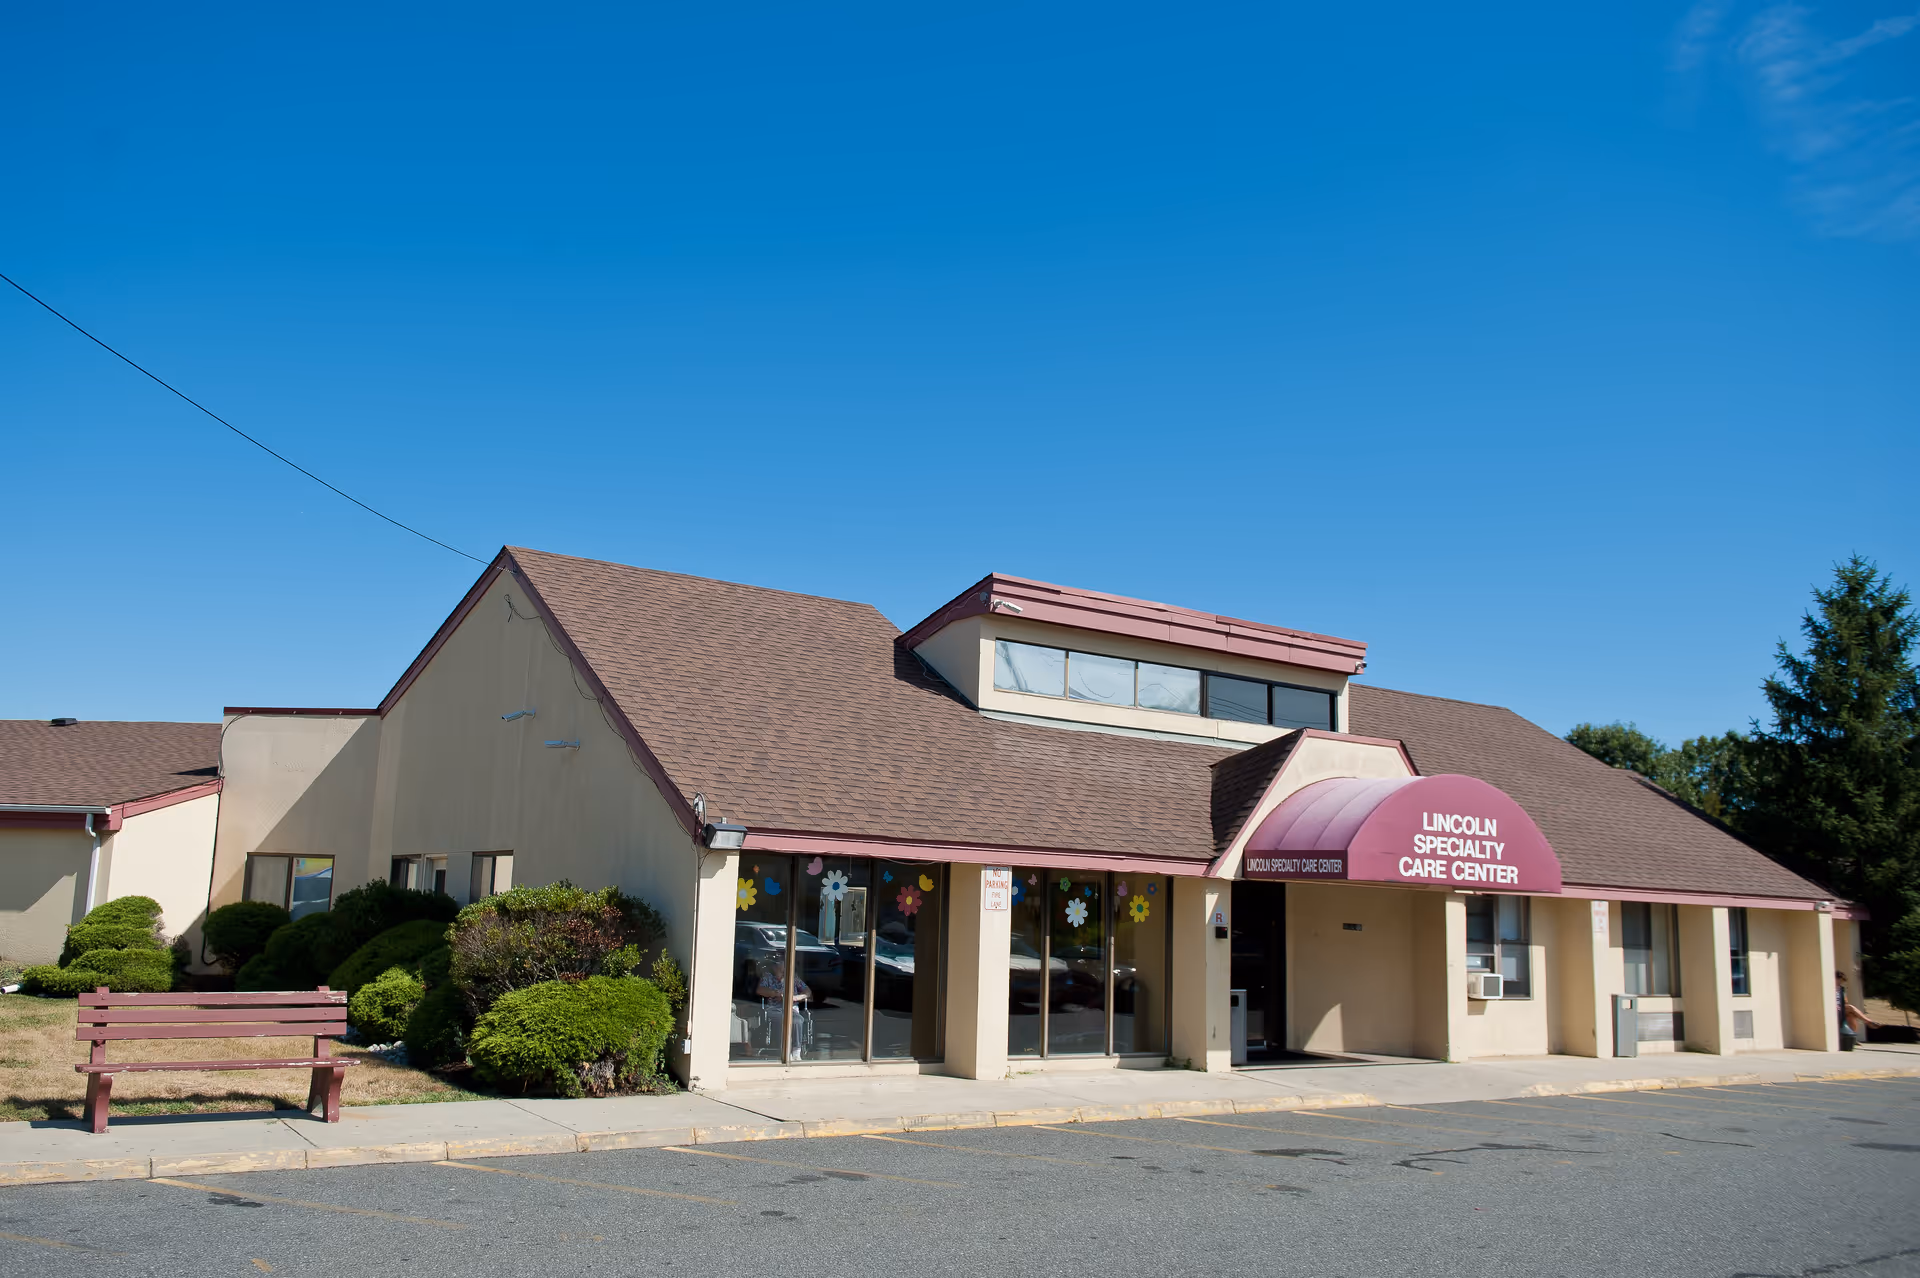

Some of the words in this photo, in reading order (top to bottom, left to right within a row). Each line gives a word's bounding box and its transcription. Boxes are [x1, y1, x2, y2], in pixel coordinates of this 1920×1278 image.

[1423, 812, 1497, 837] LINCOLN
[1413, 834, 1505, 860] SPECIALTY
[992, 868, 1001, 877] NO
[1247, 858, 1270, 872] LINCOLN
[1271, 858, 1300, 872] SPECIALTY
[1301, 858, 1317, 873] CARE
[1318, 859, 1342, 873] CENTER
[1399, 856, 1447, 879] CARE
[1451, 861, 1518, 884] CENTER
[986, 880, 1007, 889] PARKING
[1216, 913, 1223, 922] R
